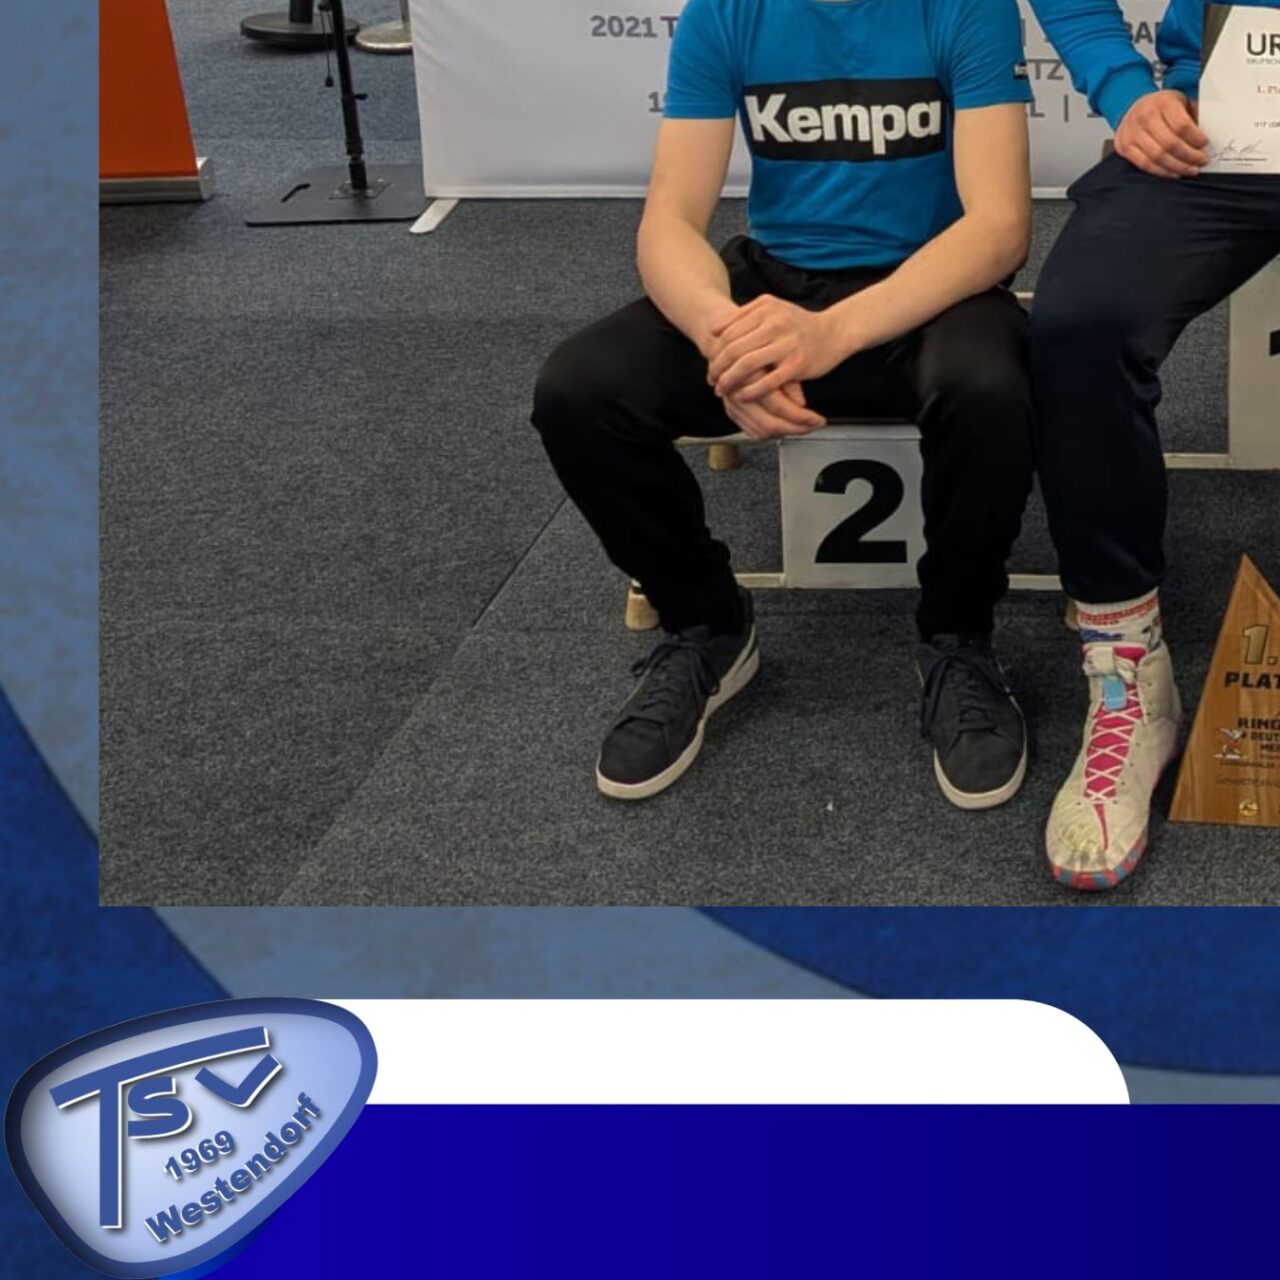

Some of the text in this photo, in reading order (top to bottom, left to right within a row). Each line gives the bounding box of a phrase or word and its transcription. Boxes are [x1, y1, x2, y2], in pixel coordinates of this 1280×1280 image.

[591, 15, 657, 38] 2021
[745, 93, 941, 154] Kempa
[814, 459, 907, 563] 2
[1242, 624, 1279, 666] 1.
